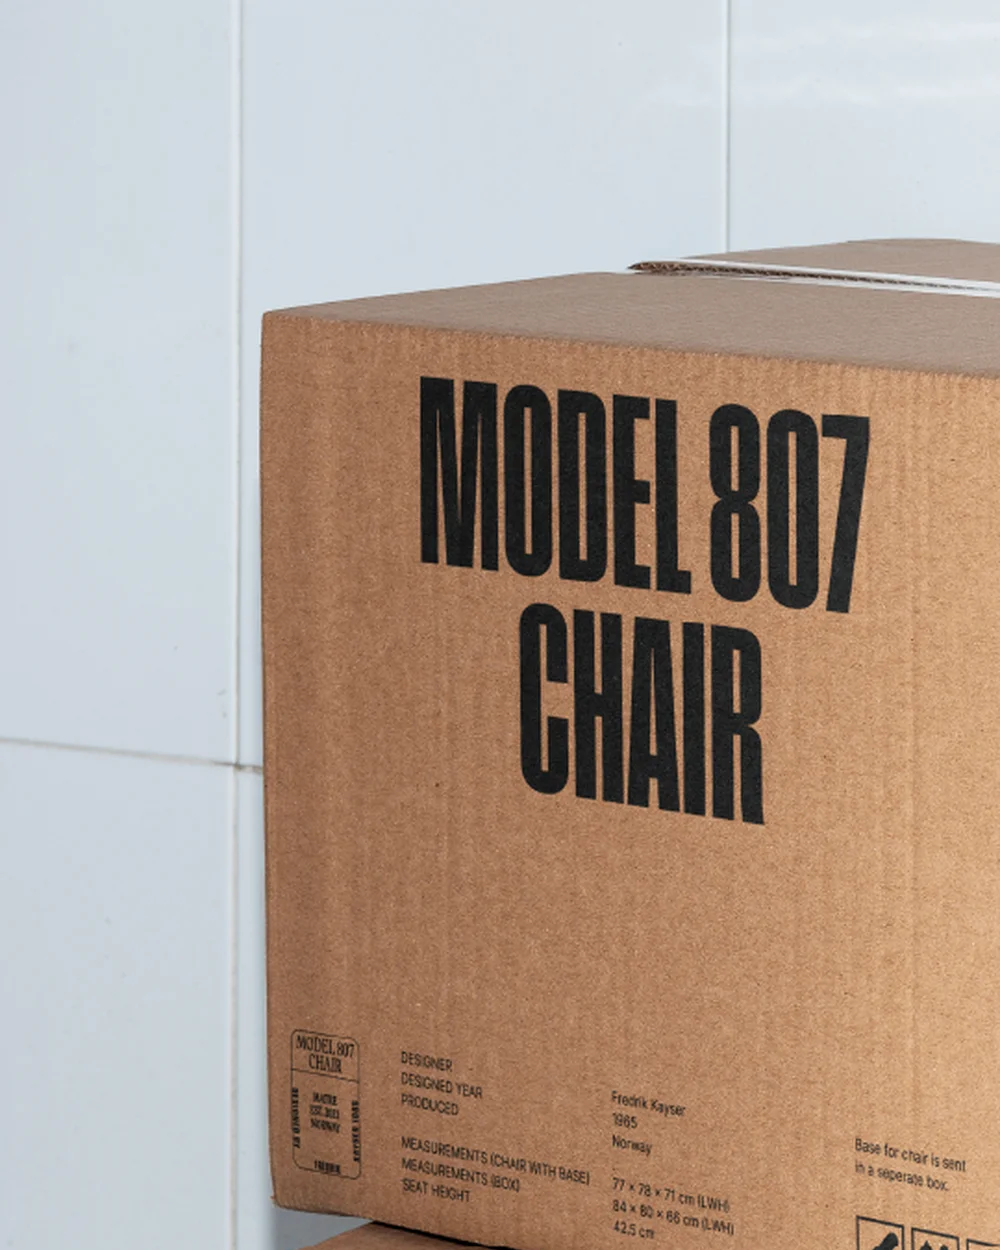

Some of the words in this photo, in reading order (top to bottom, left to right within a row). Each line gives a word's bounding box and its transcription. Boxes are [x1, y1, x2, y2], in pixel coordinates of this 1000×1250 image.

[420, 376, 692, 594] MODEL
[708, 403, 871, 614] 807
[519, 603, 766, 826] CHAIR
[295, 1035, 335, 1055] MODEL
[336, 1040, 355, 1058] 807
[308, 1053, 343, 1074] CHAIR
[401, 1050, 453, 1072] DESIGNER
[401, 1071, 453, 1094] DESIGNED
[455, 1082, 483, 1099] YEAR
[401, 1093, 459, 1116] PRODUCED
[611, 1090, 648, 1110] Fredrik
[650, 1099, 686, 1118] Kayser
[611, 1112, 638, 1129] 1965
[611, 1134, 653, 1157] Norway
[855, 1138, 881, 1155] Base
[884, 1143, 900, 1159] for
[901, 1148, 928, 1165] chair
[931, 1153, 940, 1168] is
[942, 1157, 967, 1173] sent
[401, 1136, 488, 1165] MEASUREMENTS
[490, 1151, 527, 1174] (CHAIR
[528, 1160, 557, 1178] WITH
[558, 1166, 591, 1187] BASE)
[401, 1157, 489, 1187] MEASUREMENTS
[490, 1173, 521, 1194] (BOX)
[402, 1177, 429, 1195] SEAT
[431, 1184, 471, 1203] HEIGHT
[855, 1160, 865, 1174] in
[868, 1165, 874, 1177] a
[927, 1175, 950, 1192] box.
[612, 1177, 625, 1191] 77
[638, 1183, 652, 1197] 78
[664, 1188, 676, 1200] 71
[677, 1193, 695, 1206] cm
[696, 1194, 730, 1214] (LWH)
[612, 1199, 627, 1213] 84
[639, 1204, 654, 1219] 80
[665, 1210, 681, 1225] 66
[682, 1216, 700, 1229] cm
[701, 1217, 735, 1236] (LWH)
[638, 1227, 655, 1240] cm
